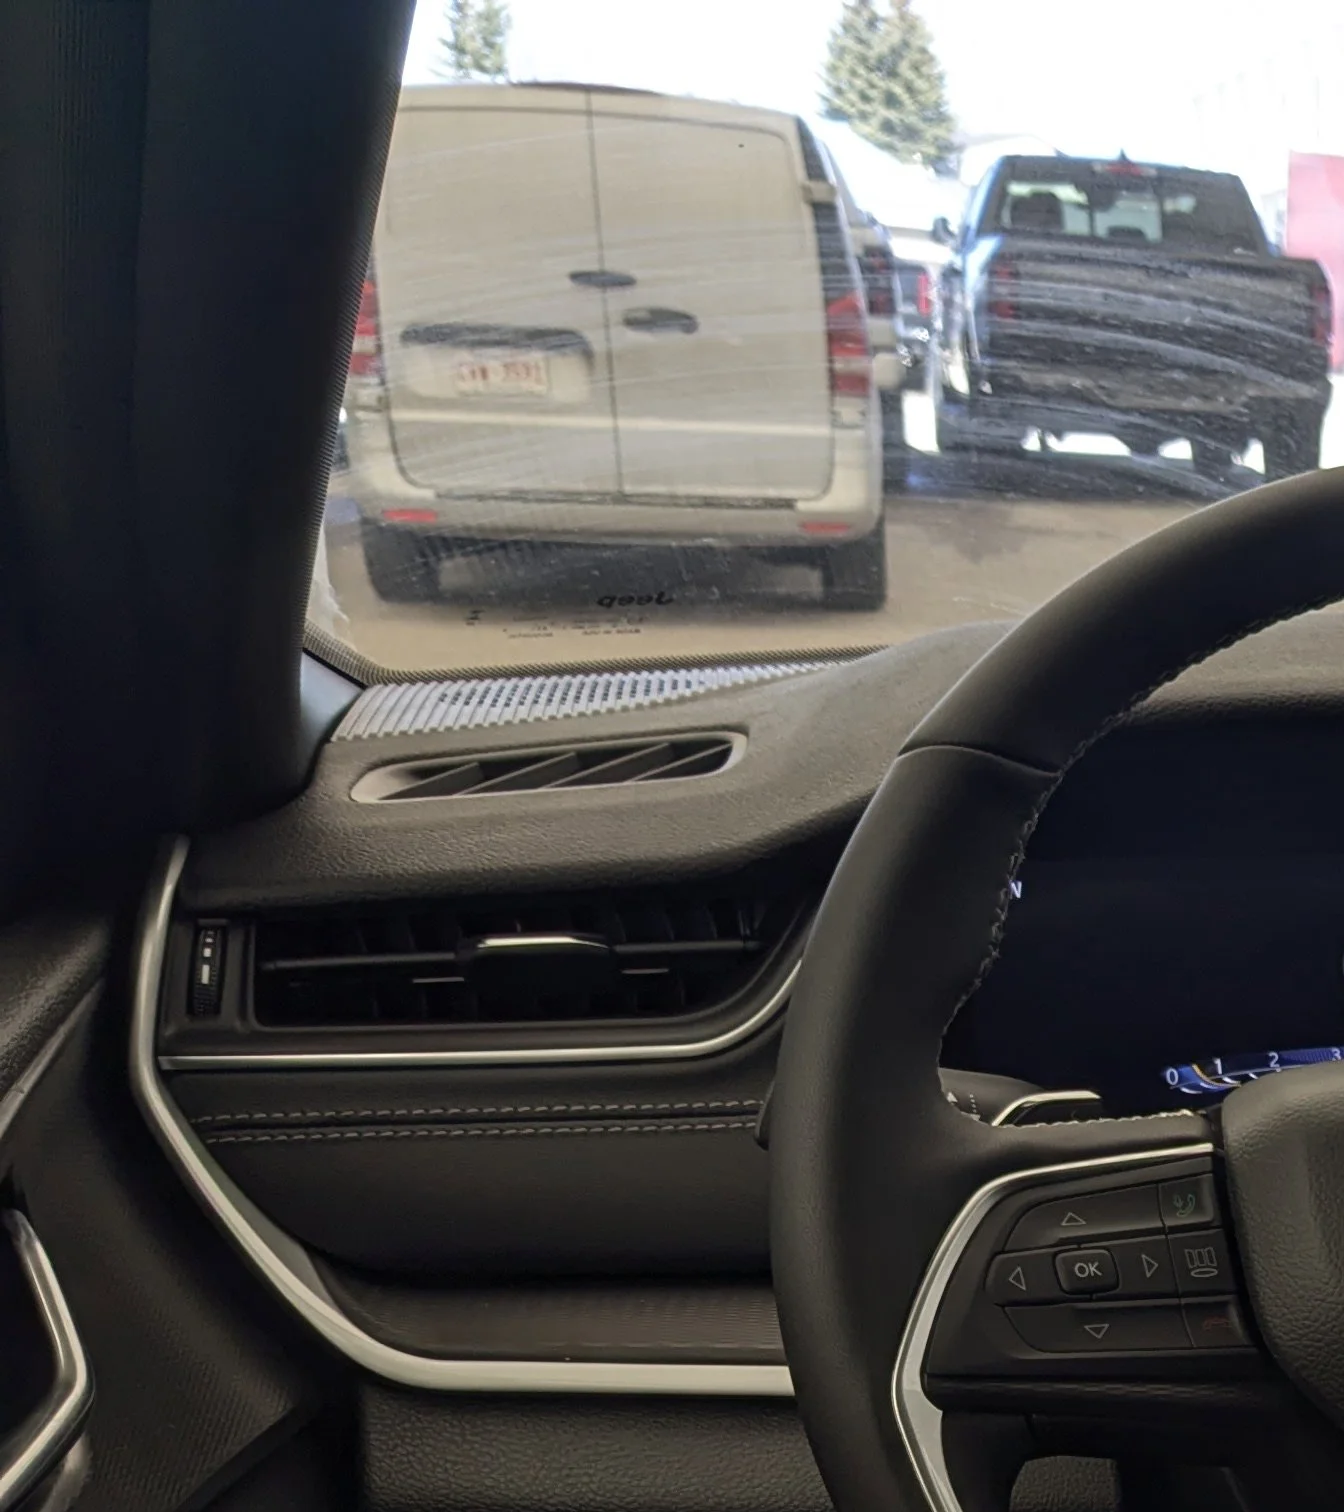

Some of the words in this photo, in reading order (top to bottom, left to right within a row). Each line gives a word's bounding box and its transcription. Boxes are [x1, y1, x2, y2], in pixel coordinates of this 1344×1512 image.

[1165, 1066, 1179, 1086] 0
[1213, 1058, 1223, 1075] 1
[1268, 1051, 1280, 1068] 2
[1074, 1262, 1102, 1278] OK
